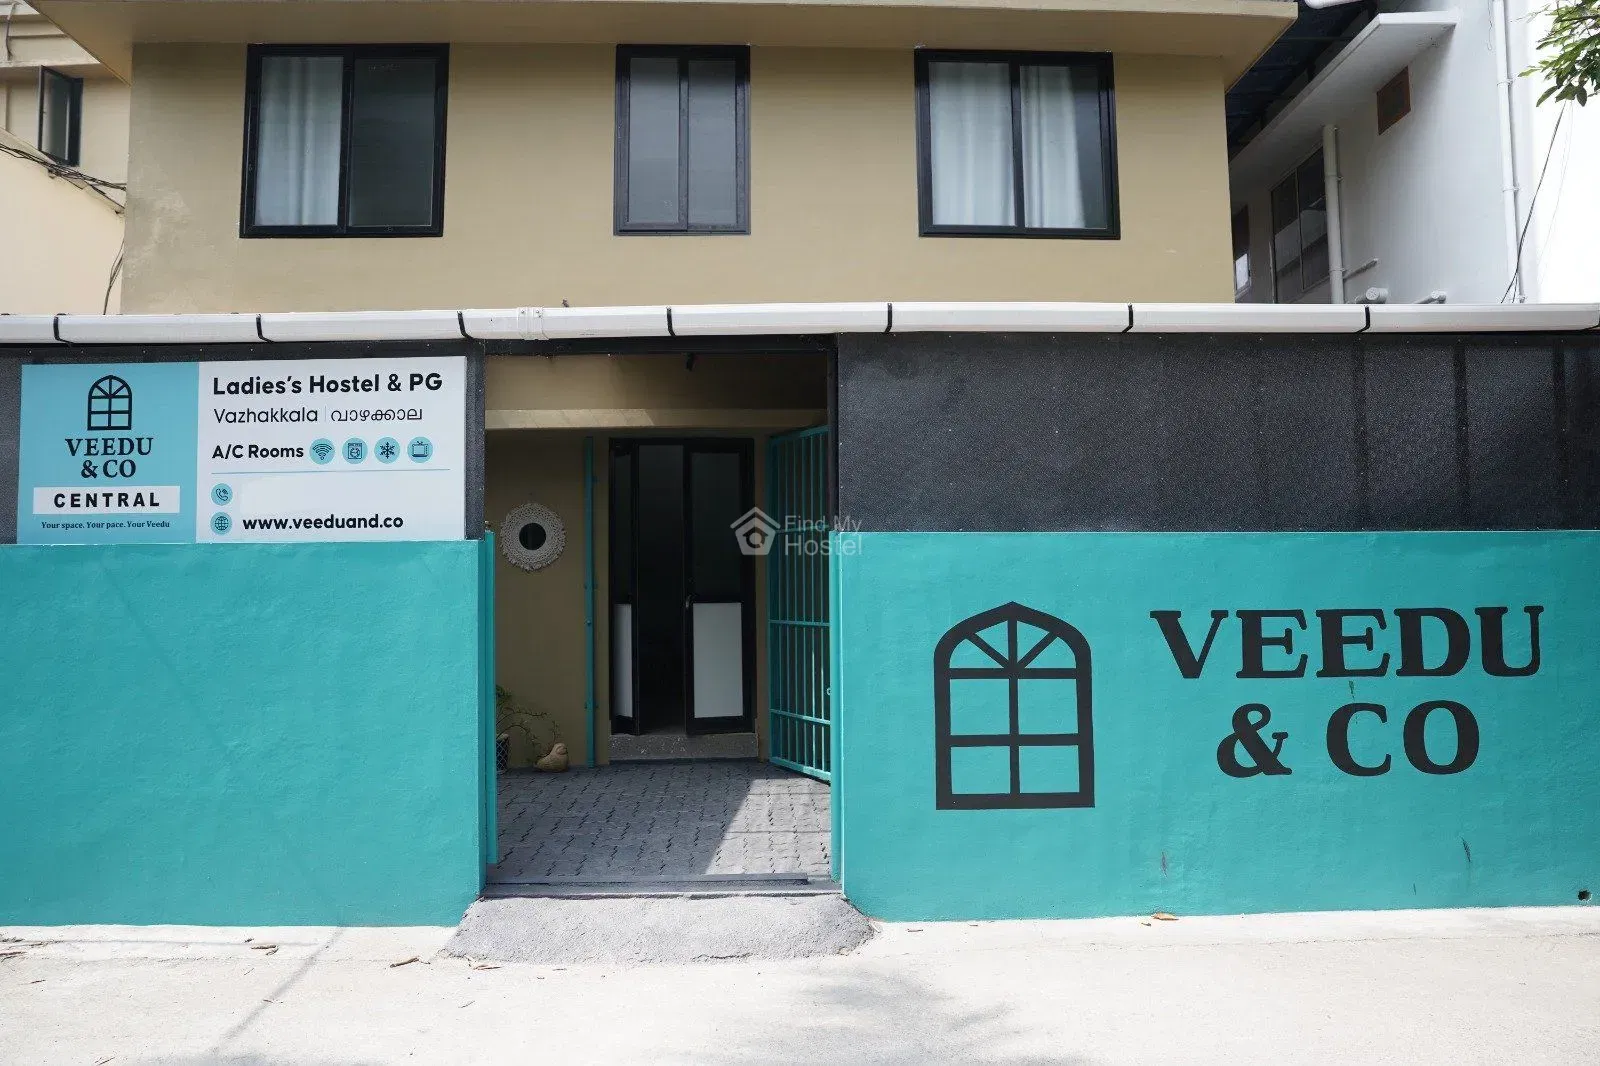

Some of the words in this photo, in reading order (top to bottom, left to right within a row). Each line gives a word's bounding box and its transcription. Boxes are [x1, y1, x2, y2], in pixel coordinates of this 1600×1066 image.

[214, 376, 302, 395] Ladies’s
[310, 374, 379, 393] Hostel
[388, 374, 401, 391] &
[410, 373, 442, 391] PG
[214, 407, 317, 423] Vazhakkala
[331, 408, 422, 422] വാഴക്കാല
[65, 437, 153, 456] VEEDU
[212, 444, 243, 459] A/C
[249, 445, 304, 458] Rooms
[81, 460, 98, 478] &
[103, 459, 136, 478] CO
[54, 493, 159, 508] CENTRAL
[41, 521, 60, 529] Your
[61, 522, 85, 530] space.
[86, 521, 105, 529] Your
[106, 521, 126, 530] pace.
[127, 520, 146, 528] Your
[146, 520, 170, 528] Veedu
[243, 514, 403, 529] www.veeduand.co
[1151, 605, 1545, 680] VEEDU
[1217, 703, 1292, 778] &
[1326, 699, 1480, 776] CO
